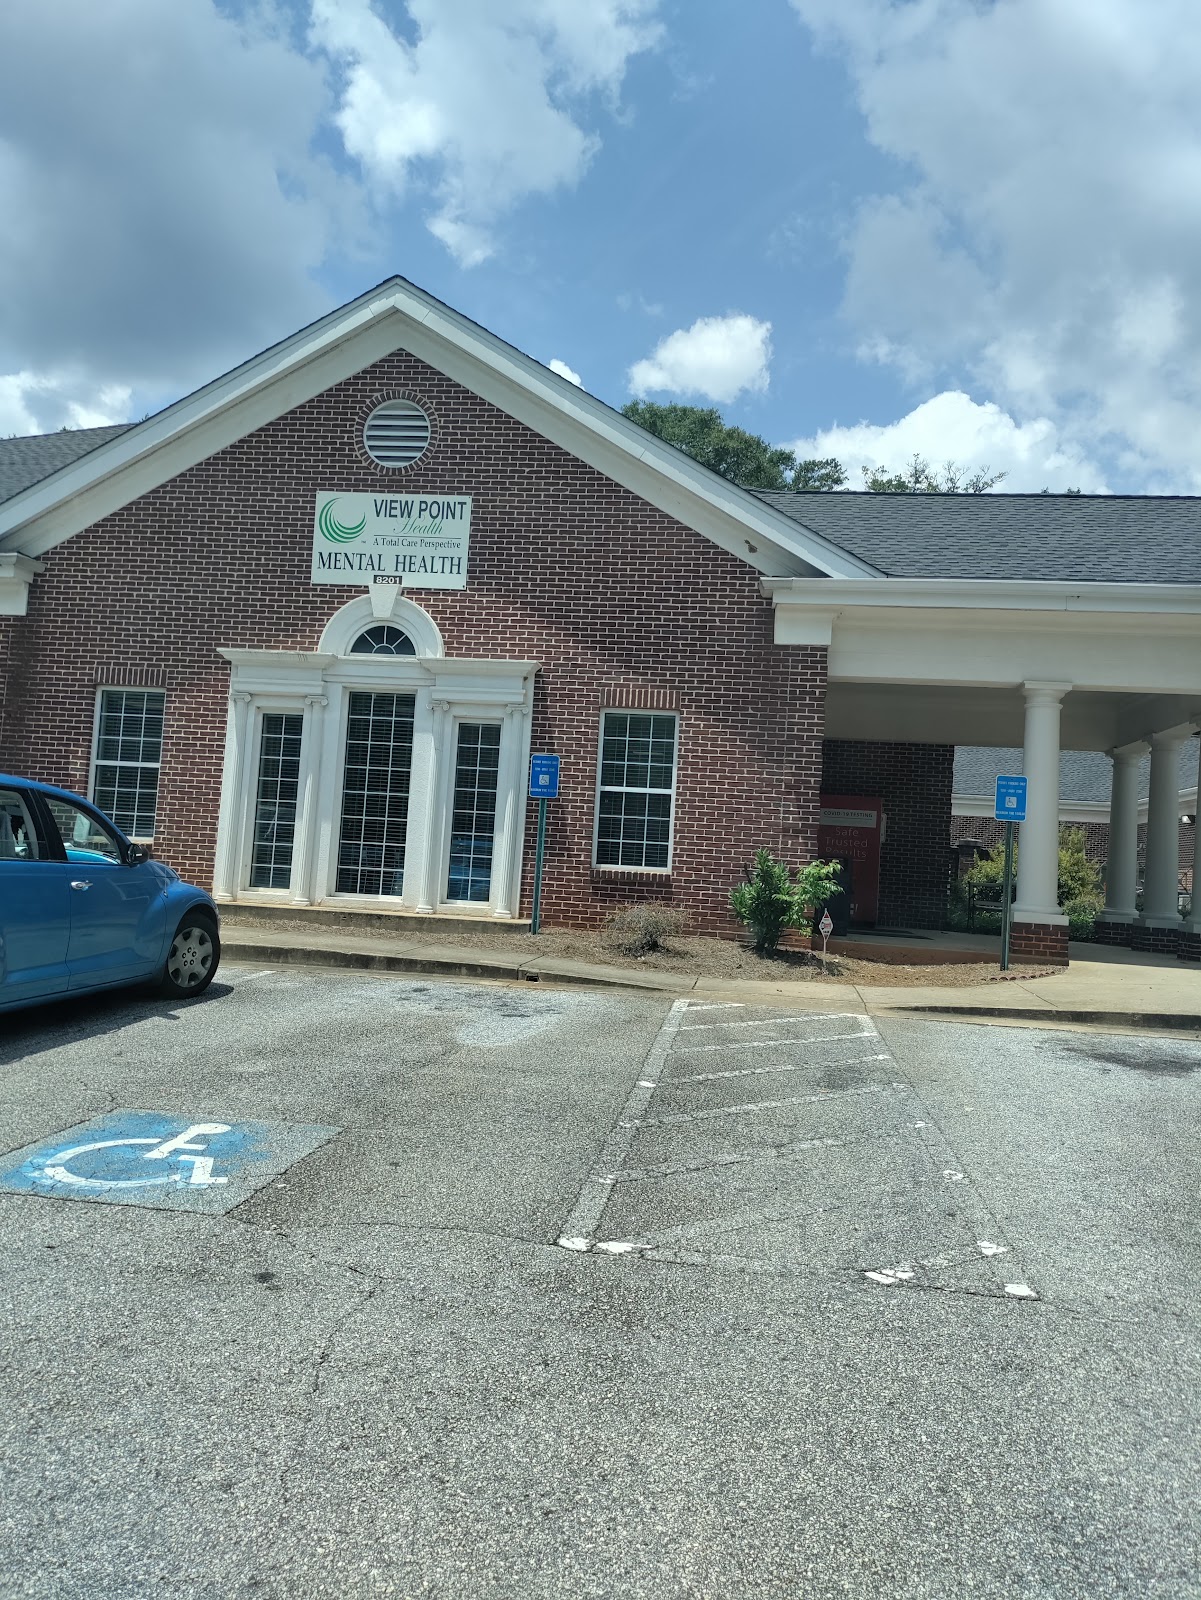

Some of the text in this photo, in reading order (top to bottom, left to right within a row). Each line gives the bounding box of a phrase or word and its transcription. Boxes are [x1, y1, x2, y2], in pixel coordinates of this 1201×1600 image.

[374, 499, 467, 520] VIEW POINT
[393, 516, 443, 535] Health
[373, 537, 461, 551] A Total Care Perspective
[317, 551, 462, 575] MENTAL HEALTH
[375, 576, 400, 584] 8201
[835, 827, 859, 837] Safe
[825, 836, 868, 848] Trusted
